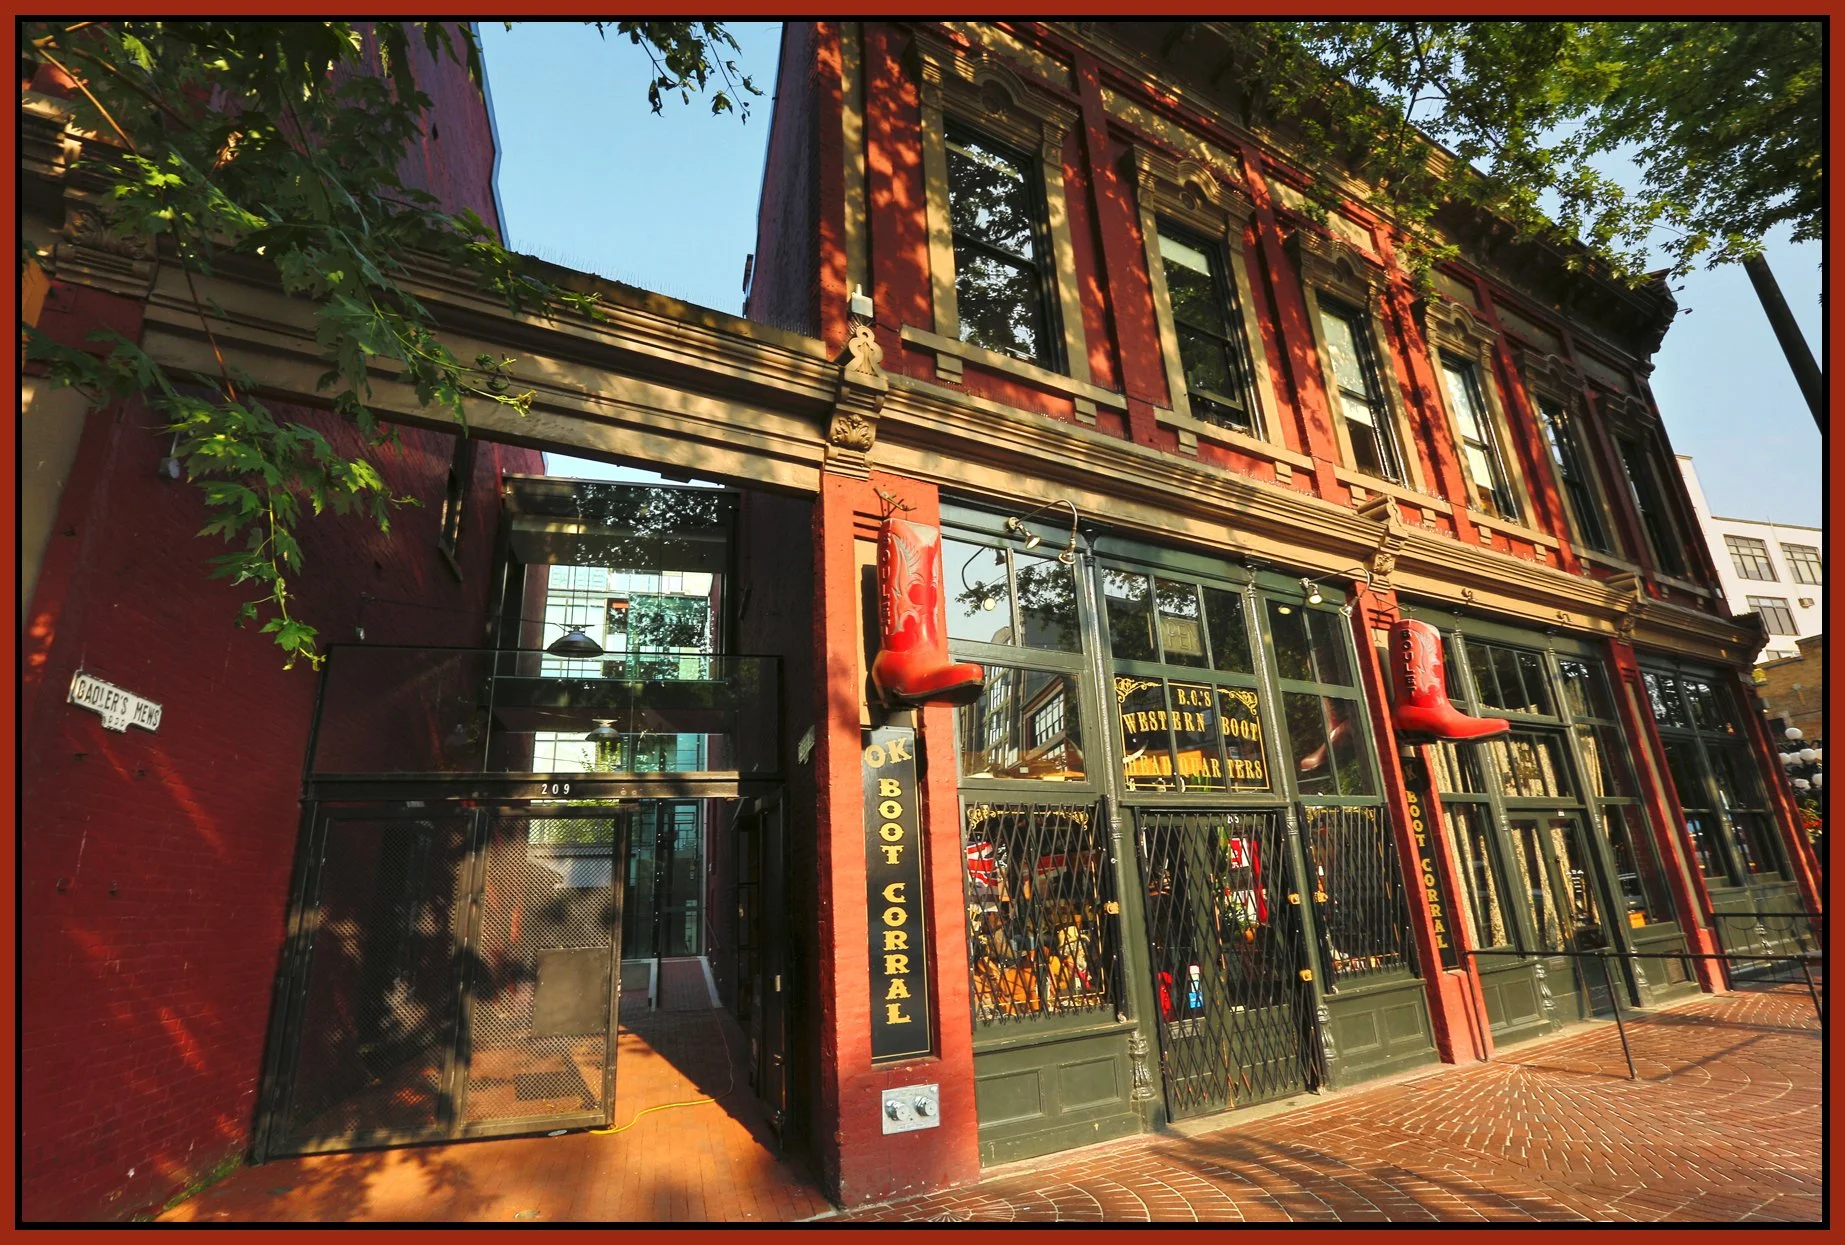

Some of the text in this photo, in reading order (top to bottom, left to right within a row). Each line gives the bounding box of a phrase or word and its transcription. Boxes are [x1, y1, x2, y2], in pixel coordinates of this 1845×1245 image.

[133, 701, 160, 727] MEWS
[1122, 710, 1259, 741] WESTERN BOOT
[863, 736, 913, 769] OK
[541, 783, 570, 795] 209
[1405, 790, 1449, 950] BOOT CORRAL
[877, 778, 913, 1025] BOOT CORRAL
